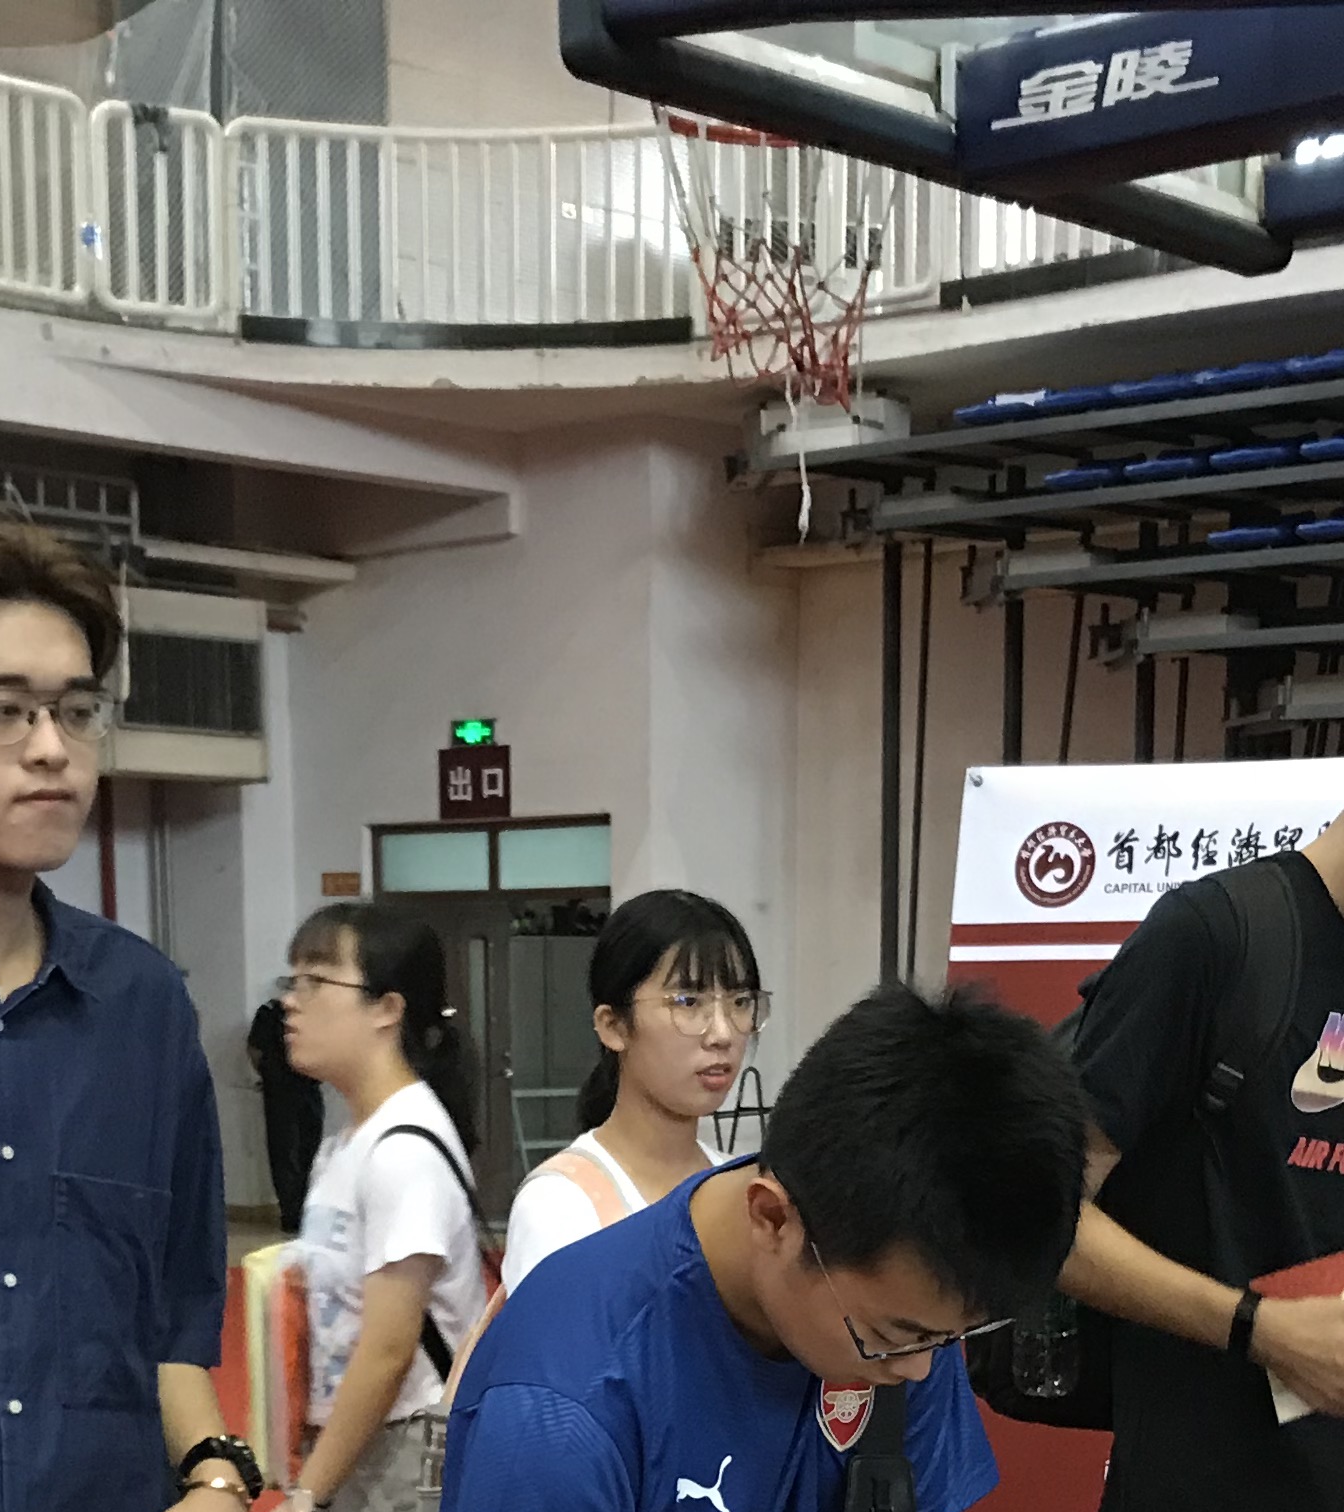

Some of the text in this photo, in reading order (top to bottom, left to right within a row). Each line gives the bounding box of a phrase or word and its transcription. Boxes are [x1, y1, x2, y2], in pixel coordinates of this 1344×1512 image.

[990, 39, 1220, 131] 金陵
[448, 766, 504, 801] 出口
[1104, 882, 1154, 895] CAPITAL
[1287, 1137, 1330, 1170] AIR
